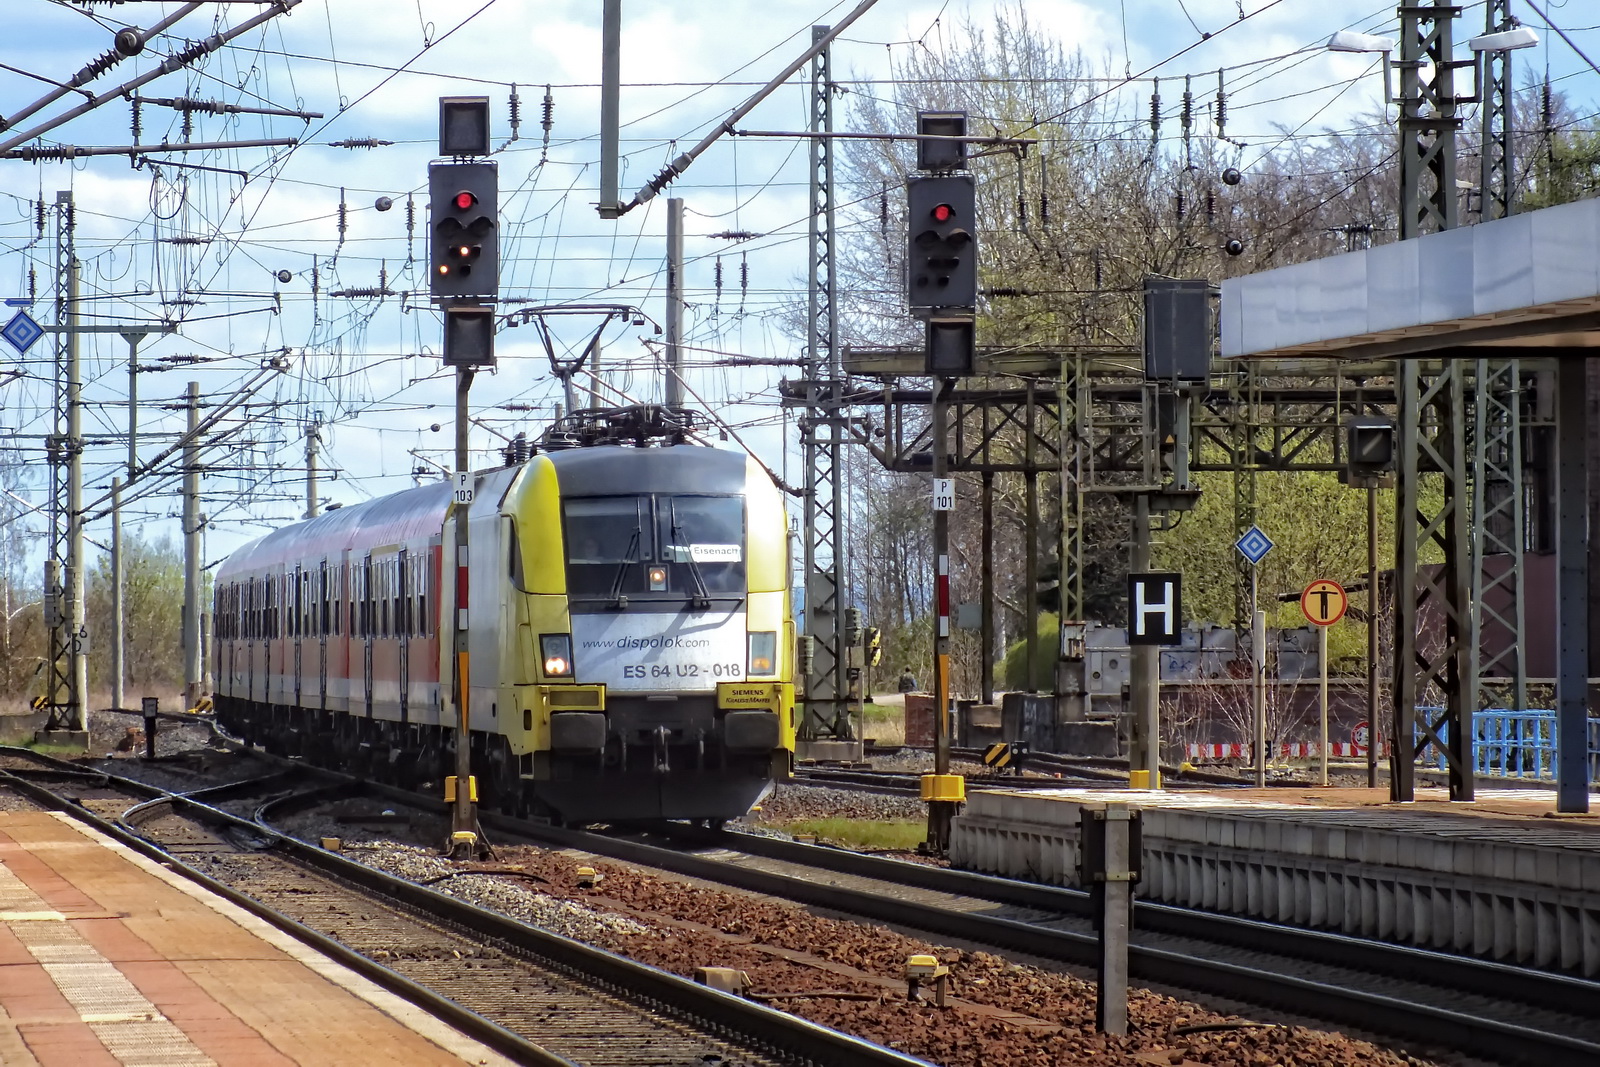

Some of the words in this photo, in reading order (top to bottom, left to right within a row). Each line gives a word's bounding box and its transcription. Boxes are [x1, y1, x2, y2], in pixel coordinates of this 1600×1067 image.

[461, 474, 467, 486] P
[941, 481, 947, 493] P
[455, 490, 473, 502] 103
[937, 496, 952, 508] 101
[693, 546, 739, 555] Eisenach
[1135, 582, 1174, 636] H
[582, 635, 710, 651] www.dispolok.com
[623, 665, 647, 679] ES
[651, 664, 671, 678] 64
[676, 664, 699, 678] U2
[712, 663, 741, 677] 018
